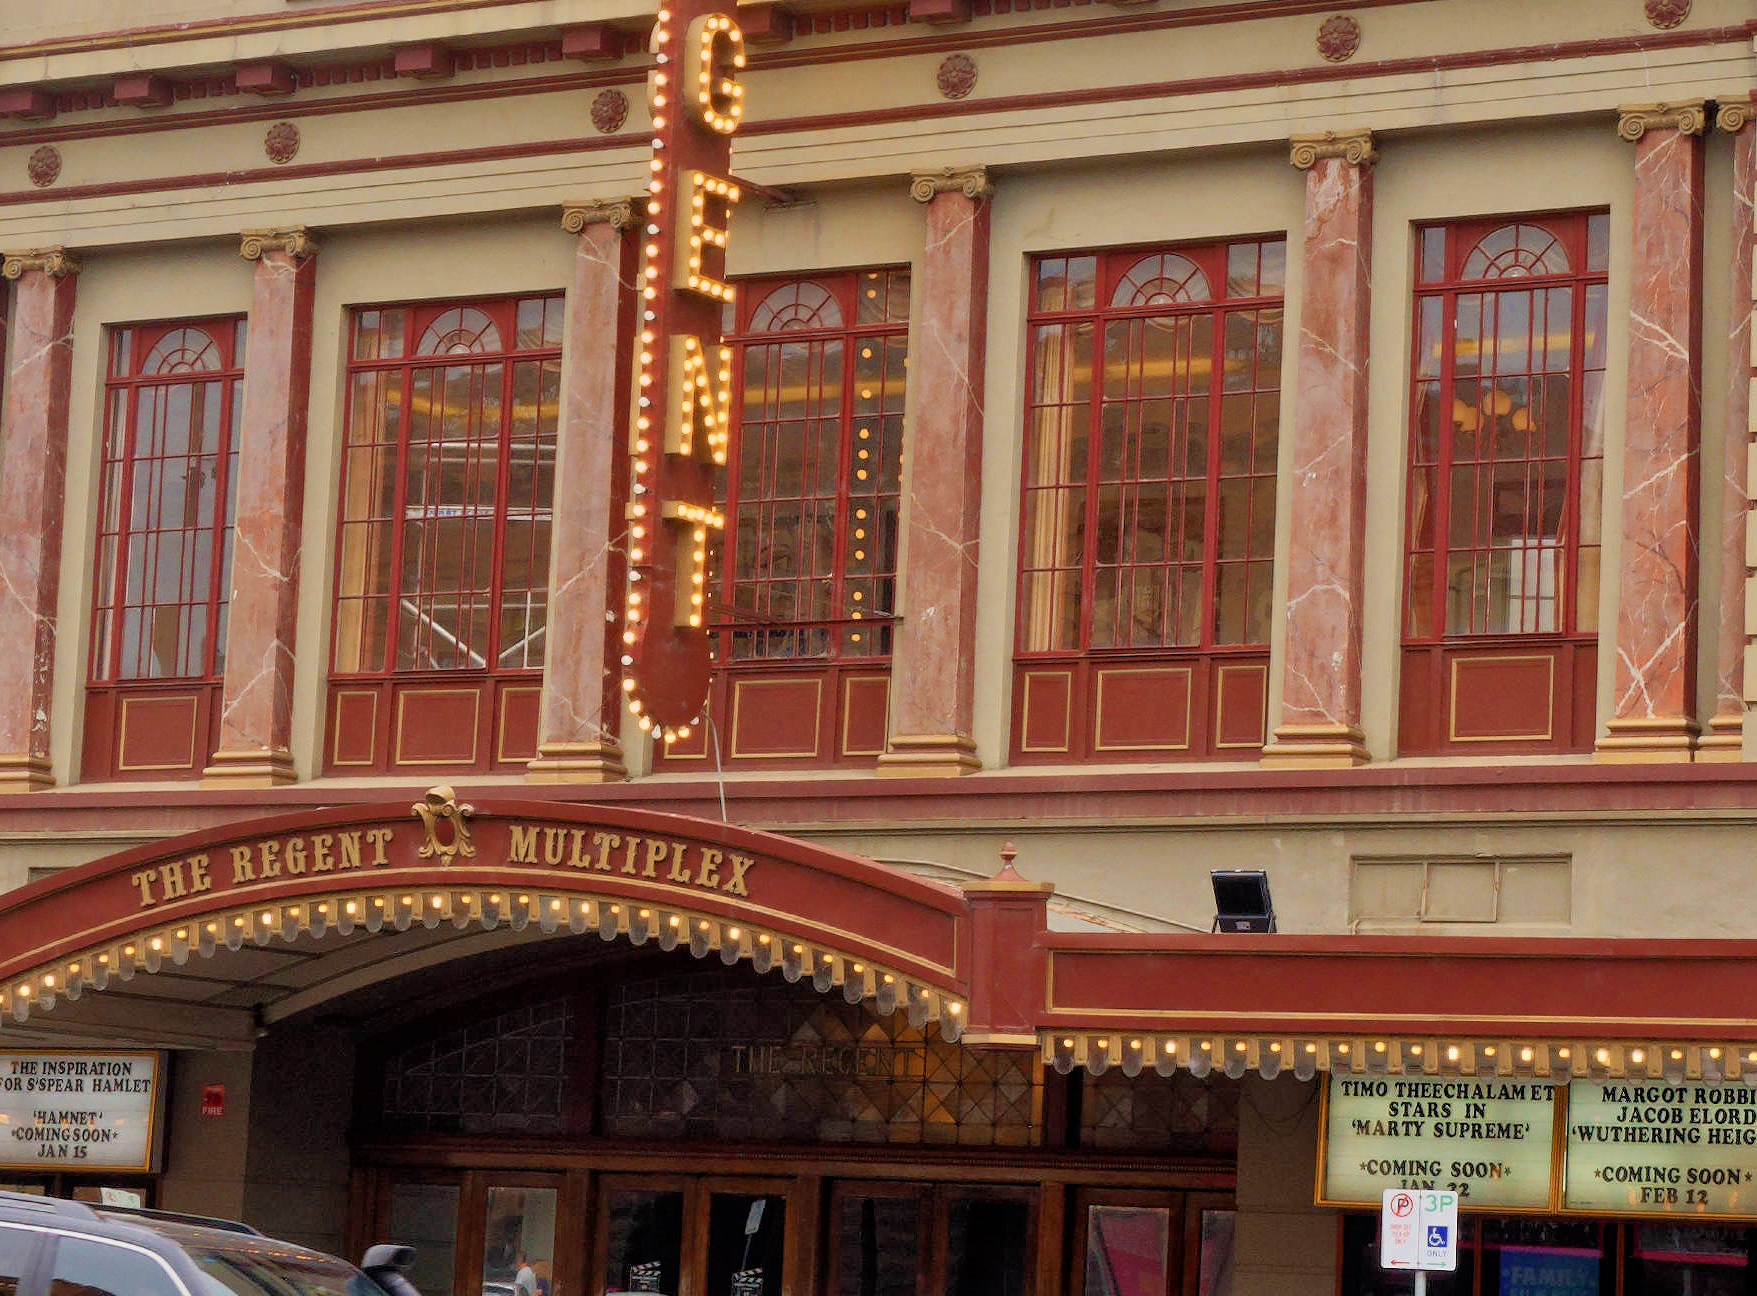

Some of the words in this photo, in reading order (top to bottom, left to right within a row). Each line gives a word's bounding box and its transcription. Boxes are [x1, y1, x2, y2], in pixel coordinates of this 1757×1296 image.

[132, 854, 212, 907] THE
[229, 828, 393, 884] REGENT
[507, 825, 755, 897] MULTIPLEX
[11, 1061, 37, 1075] THE
[42, 1061, 133, 1076] INSPIRATION
[731, 1045, 783, 1075] THE
[26, 1078, 84, 1092] S'SPEAR
[92, 1078, 151, 1093] HAMLET
[1341, 1080, 1388, 1097] TIMO
[1602, 1086, 1688, 1103] MARGOT
[203, 1106, 223, 1116] FIRE
[1388, 1102, 1452, 1118] STARS
[1464, 1103, 1486, 1119] IN
[1617, 1107, 1683, 1123] JACOB
[38, 1144, 68, 1158] JAN
[73, 1146, 88, 1158] 15
[1425, 1194, 1454, 1212] 3P
[1640, 1187, 1679, 1204] FEB
[1686, 1189, 1708, 1205] 12
